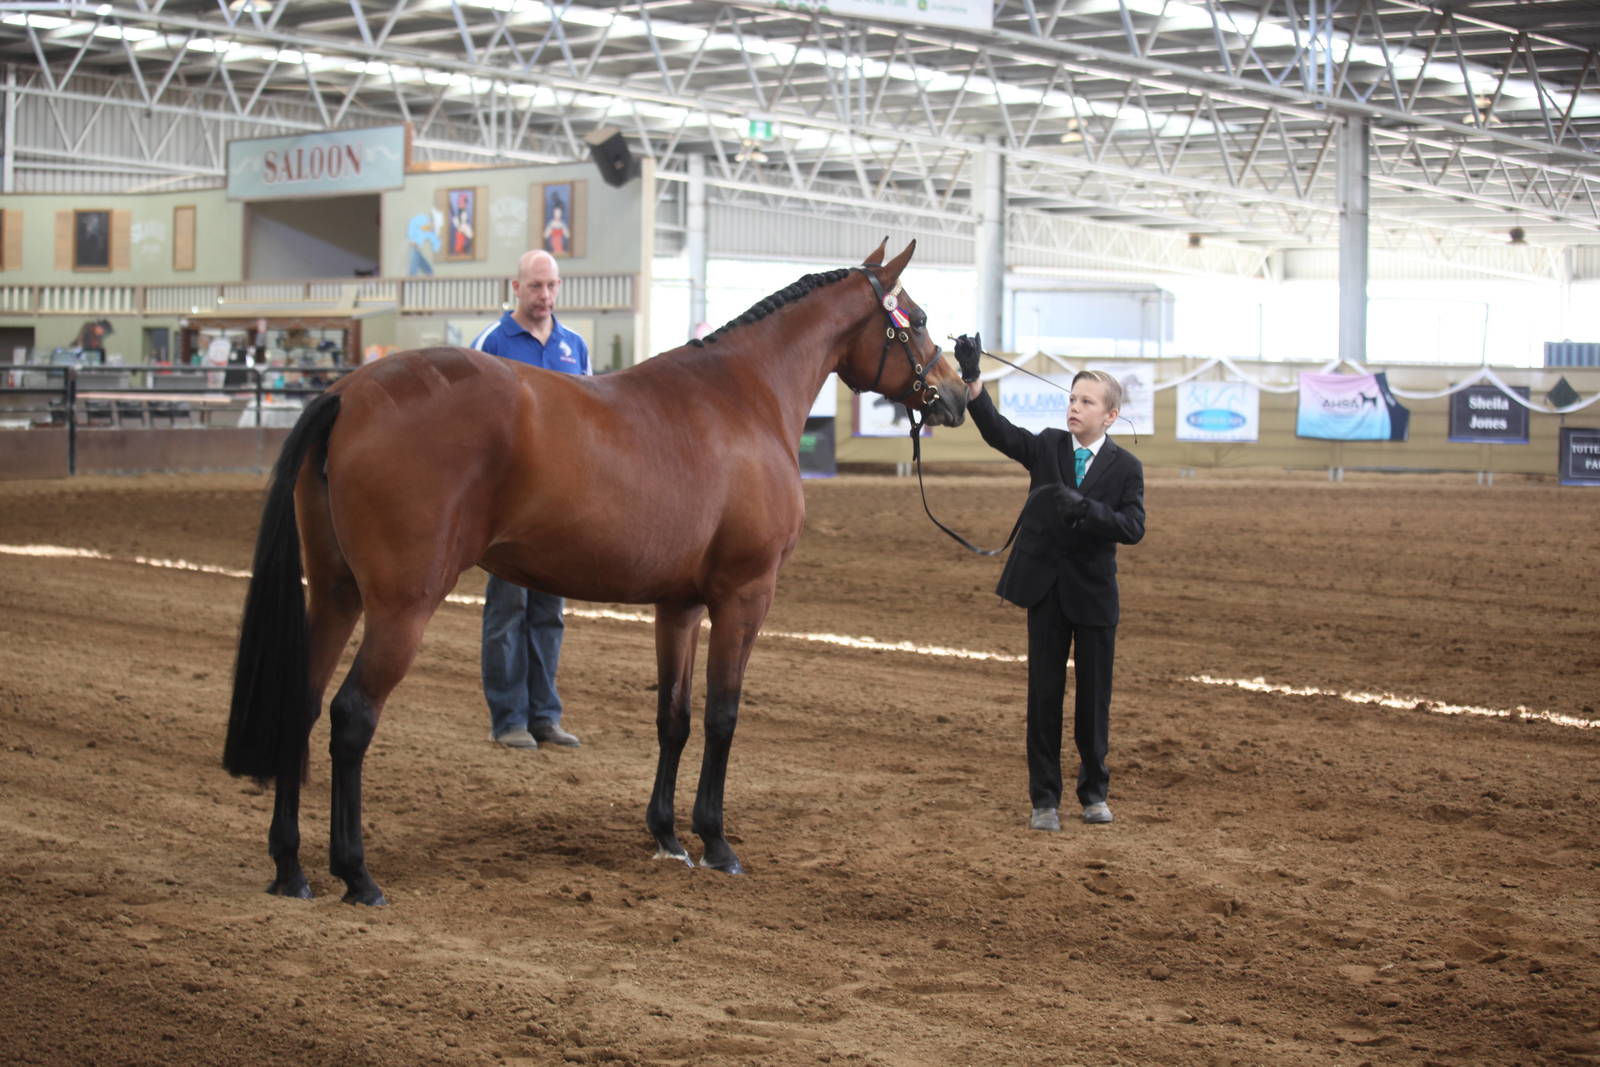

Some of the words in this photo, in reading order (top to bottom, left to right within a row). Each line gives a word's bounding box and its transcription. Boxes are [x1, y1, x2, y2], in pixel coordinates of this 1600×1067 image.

[263, 144, 364, 184] SALOON
[1468, 394, 1510, 411] Sheila
[1469, 414, 1508, 430] Jones
